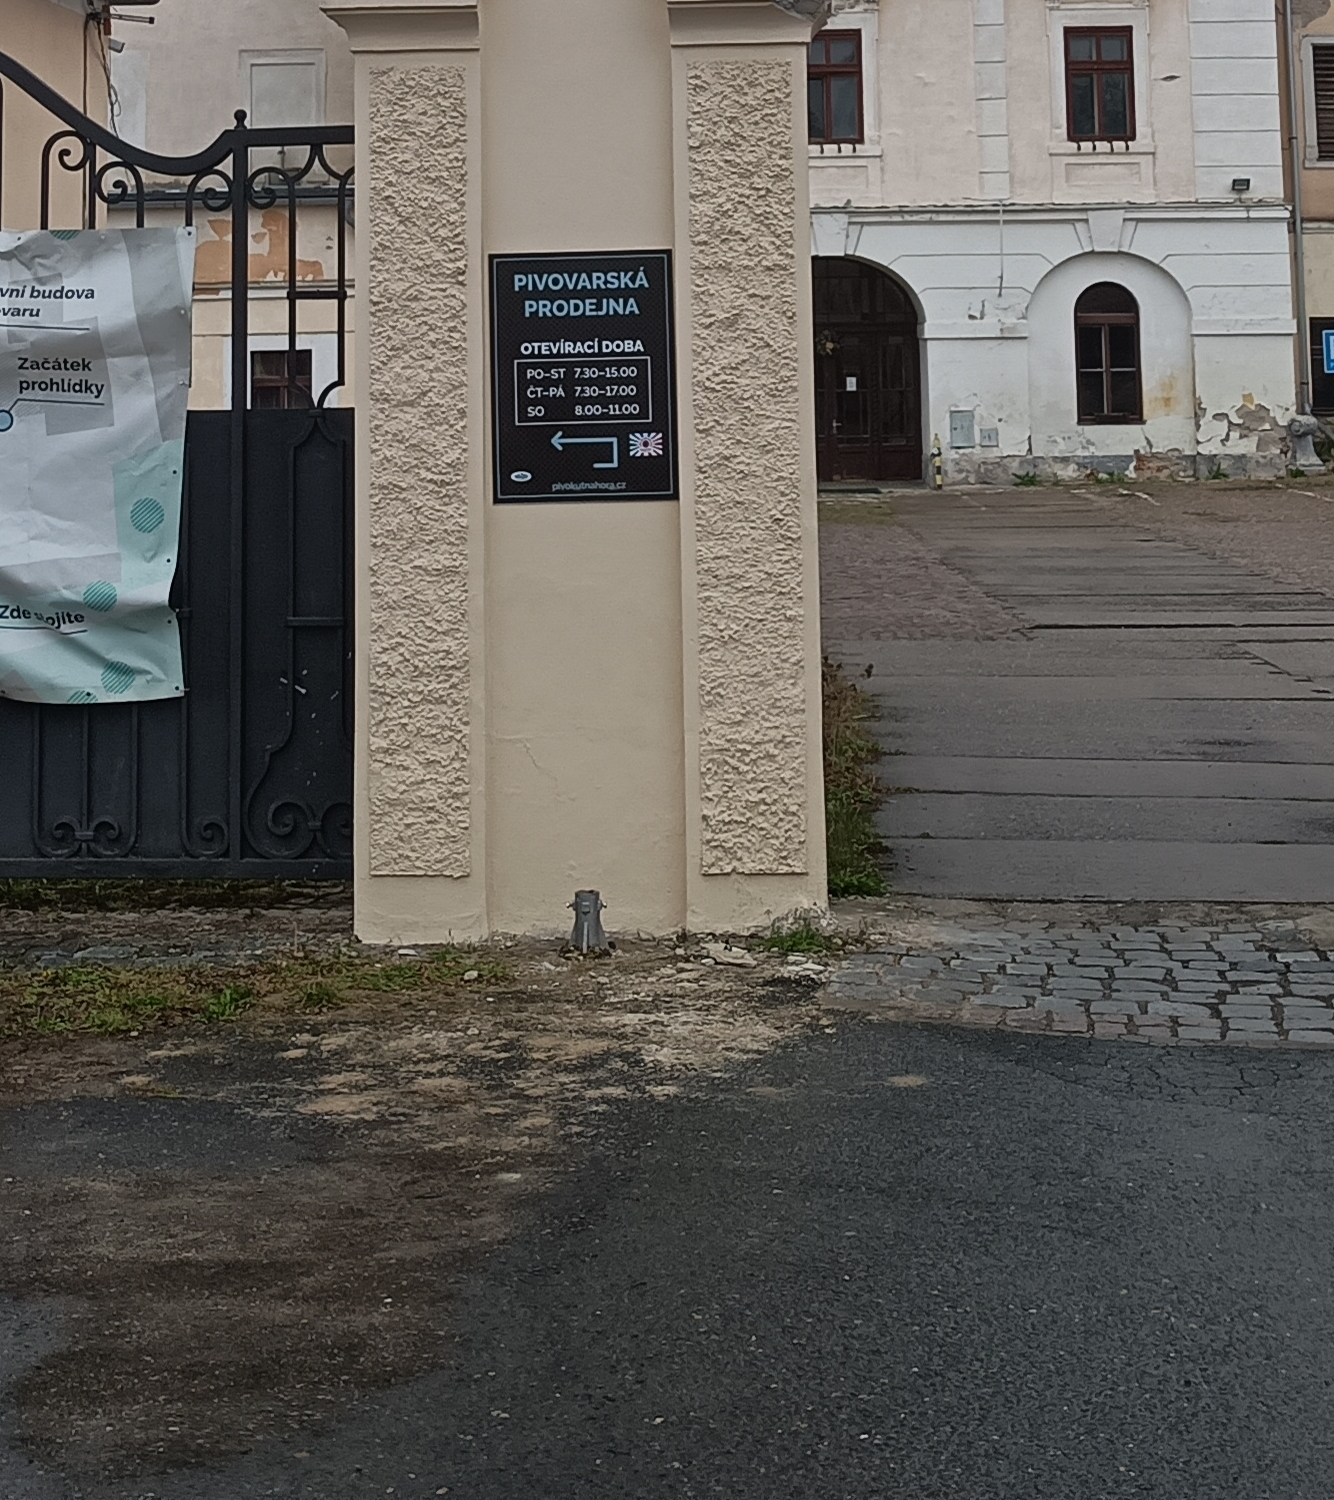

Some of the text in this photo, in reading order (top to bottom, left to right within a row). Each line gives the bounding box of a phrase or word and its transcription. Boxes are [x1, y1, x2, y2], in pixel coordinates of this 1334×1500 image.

[514, 266, 650, 292] PIVOVARSKÁ
[29, 285, 95, 299] budova
[524, 298, 640, 317] PRODEJNA
[520, 338, 645, 355] OTEVÍRACÍ DOBA
[17, 357, 92, 372] Začátek
[19, 378, 105, 399] prohlídky
[527, 406, 545, 417] SO
